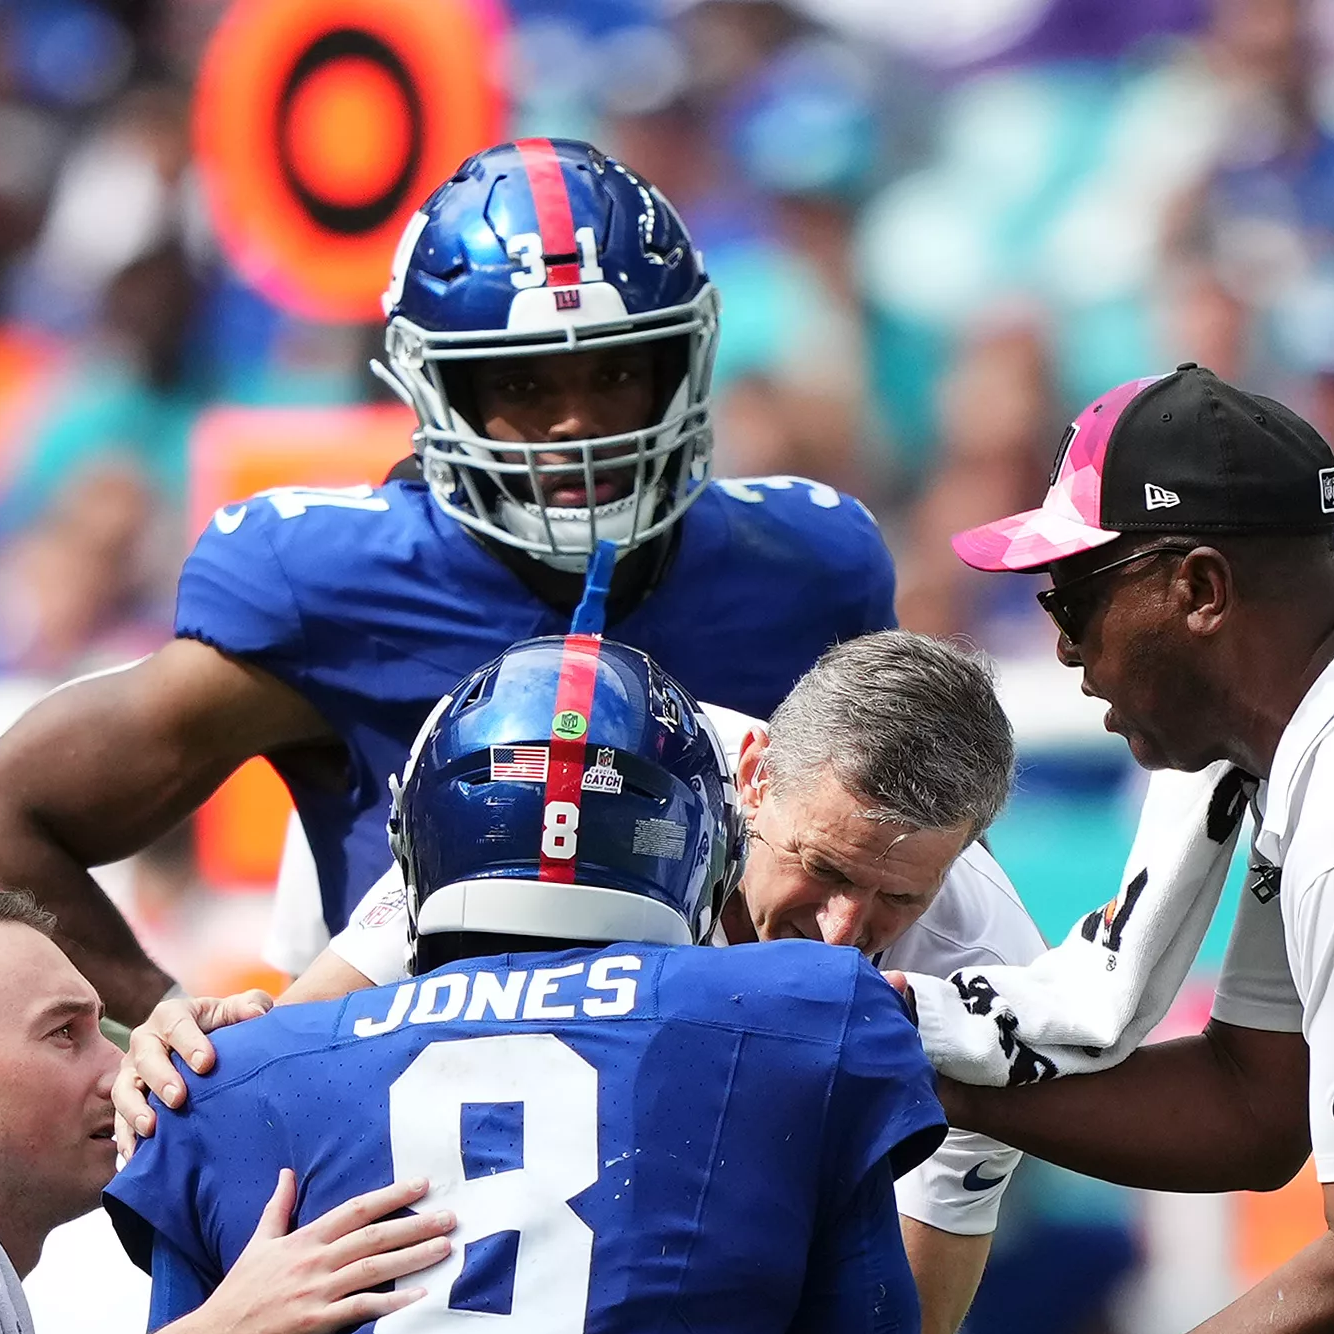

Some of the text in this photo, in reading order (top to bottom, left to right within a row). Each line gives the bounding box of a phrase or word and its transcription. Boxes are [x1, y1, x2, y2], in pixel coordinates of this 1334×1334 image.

[506, 226, 605, 289] 31
[584, 774, 622, 788] CATCH
[541, 801, 580, 860] 8
[353, 954, 643, 1039] JONES
